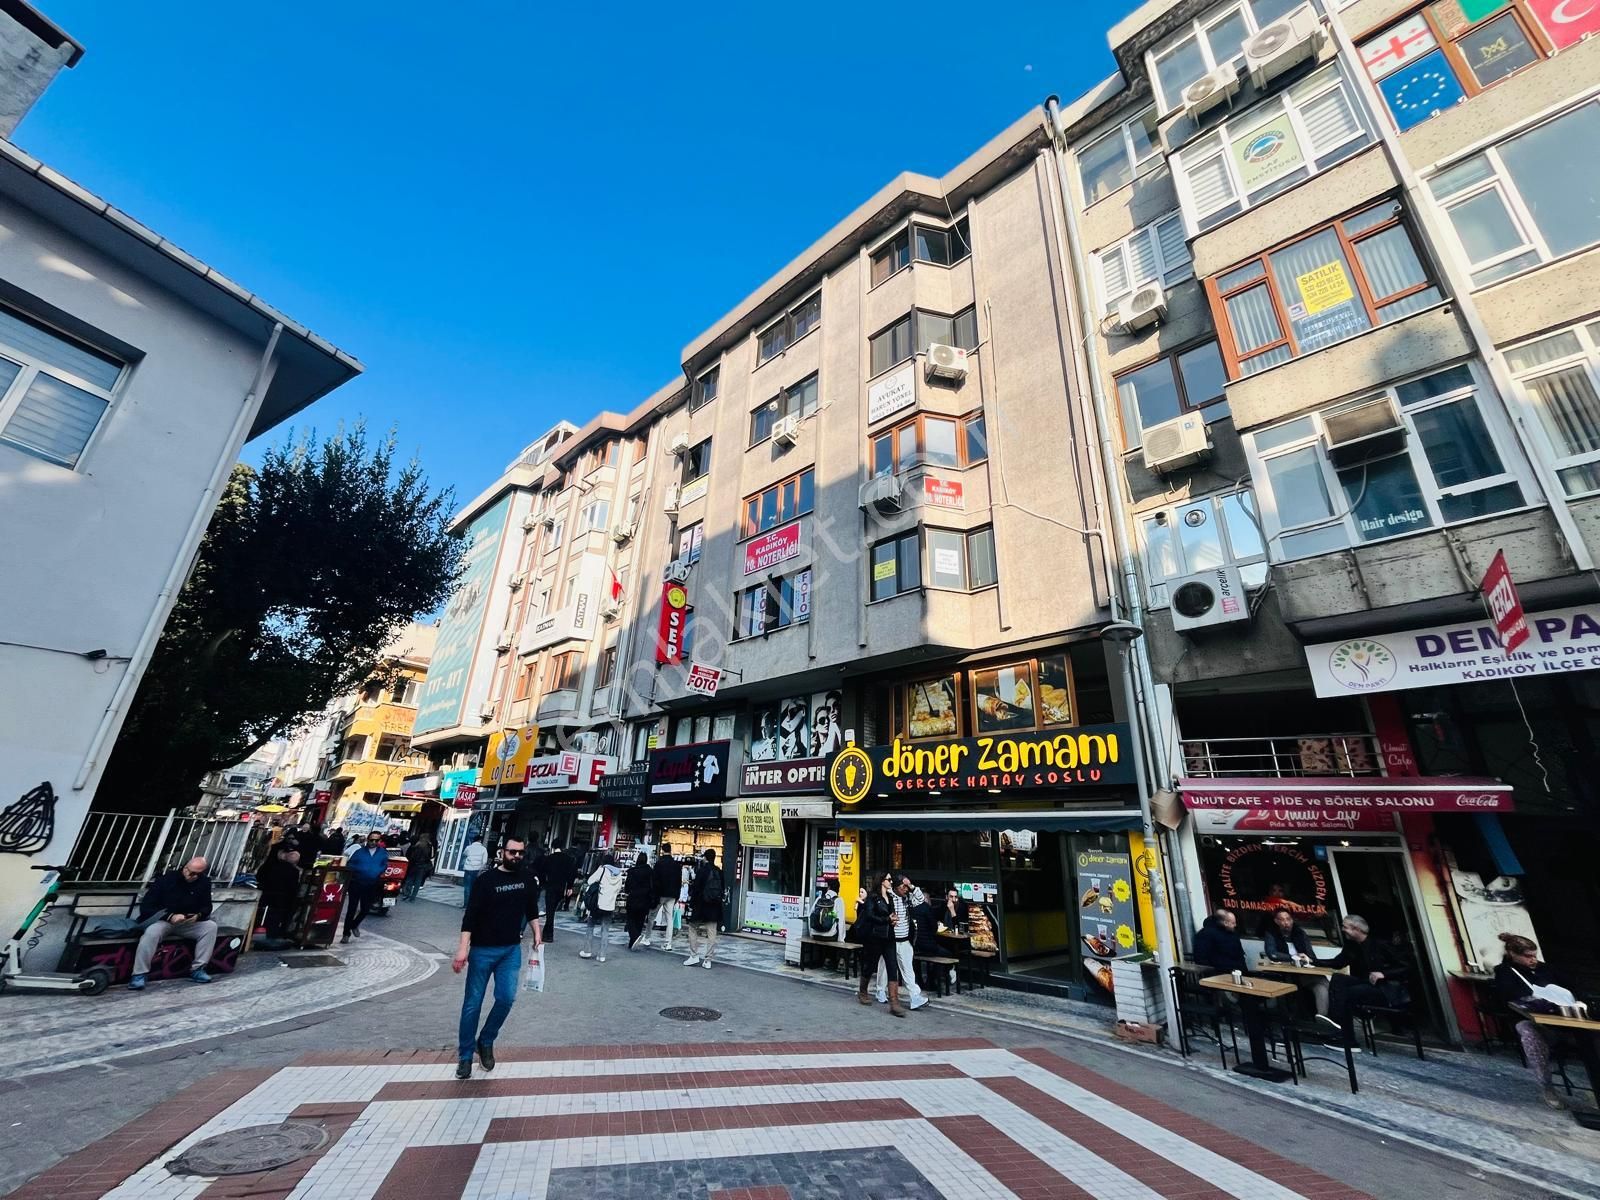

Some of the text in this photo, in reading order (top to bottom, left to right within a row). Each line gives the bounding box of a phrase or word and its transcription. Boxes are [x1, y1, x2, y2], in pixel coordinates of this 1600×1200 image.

[1301, 264, 1340, 286] SATILIK
[1360, 509, 1425, 532] Hair design
[746, 539, 797, 572] 10. NOTERLİĞİ
[755, 536, 788, 555] KADIKÖY
[800, 573, 808, 613] FOTO
[1216, 568, 1231, 596] arçelik
[666, 612, 680, 659] SEP
[1408, 659, 1477, 673] Halkların
[1482, 651, 1534, 666] Eşitlik
[1538, 648, 1558, 658] ve
[1462, 663, 1538, 680] KADIKÖY
[1543, 659, 1586, 672] İLÇE
[687, 674, 717, 691] FOTO
[882, 733, 1119, 777] döner zamanı
[491, 764, 515, 780] LOET
[895, 769, 1101, 791] GERÇEK HATAY SOSLU
[1191, 796, 1226, 805] UMUT
[1228, 796, 1262, 805] CAFE
[1273, 795, 1303, 806] PİDE
[1305, 798, 1321, 806] ve
[1326, 795, 1372, 806] BÖREK
[1375, 797, 1435, 806] SALONU
